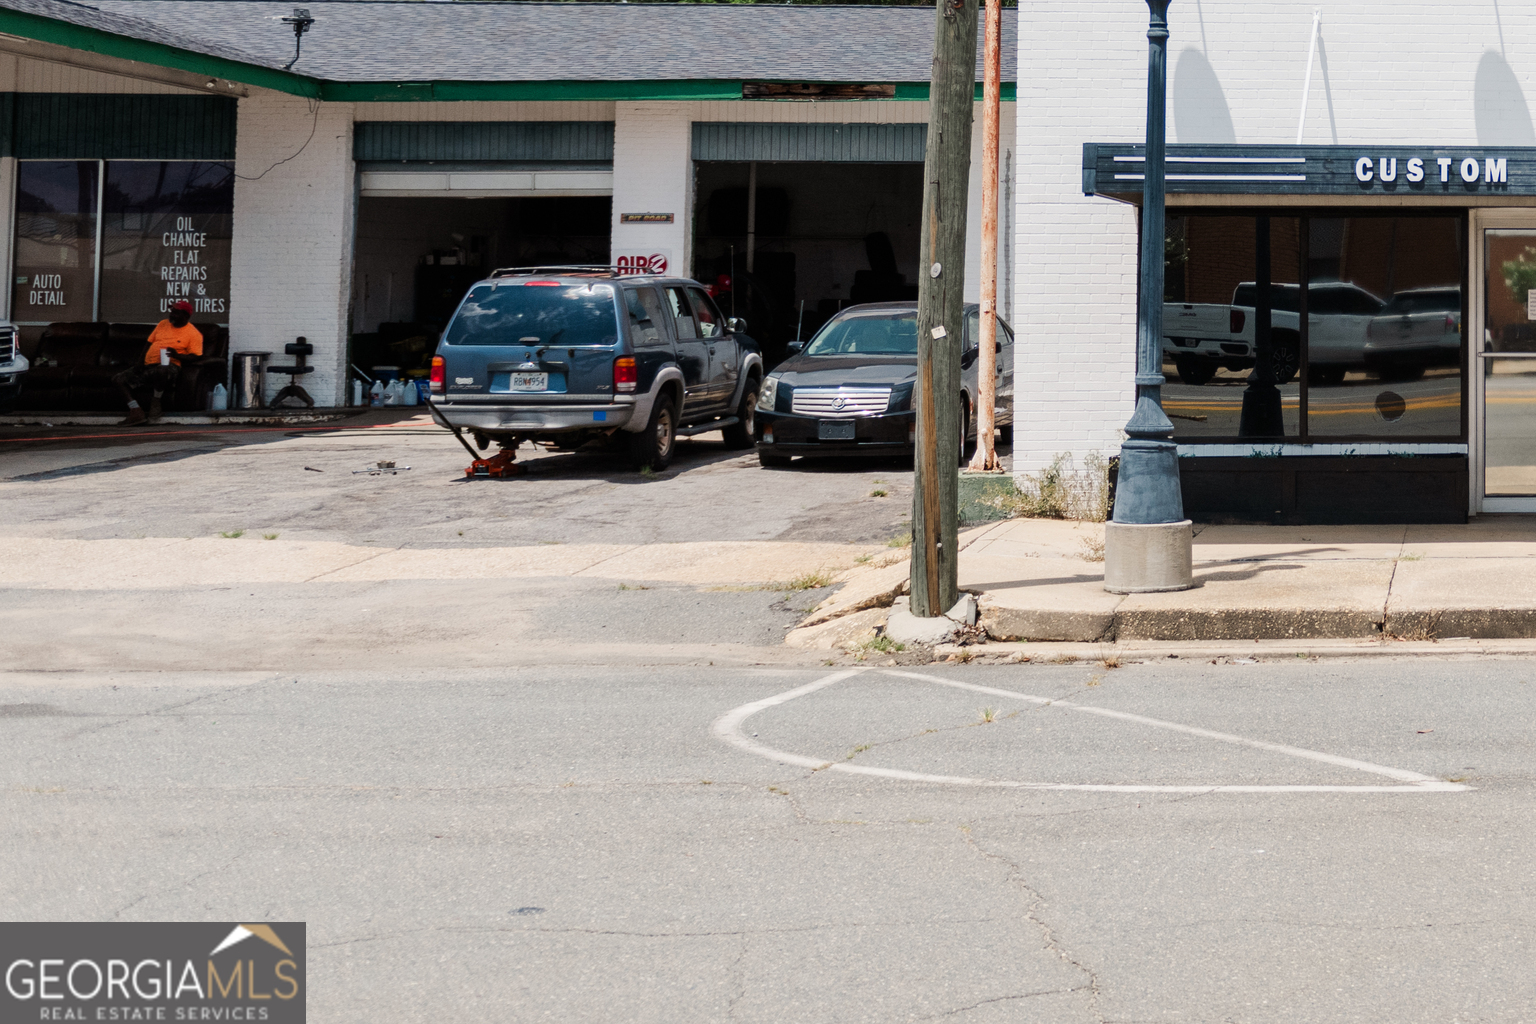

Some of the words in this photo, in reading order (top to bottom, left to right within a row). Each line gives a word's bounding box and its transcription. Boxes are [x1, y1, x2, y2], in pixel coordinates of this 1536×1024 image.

[1355, 156, 1508, 183] CUSTOM
[176, 216, 195, 231] OIL
[162, 232, 207, 247] CHANGE
[174, 250, 200, 265] FLAT
[161, 266, 208, 281] REPAIRS
[32, 274, 62, 289] AUTO
[166, 282, 191, 296] NEW
[197, 283, 206, 296] &
[29, 291, 67, 306] DETAIL
[160, 298, 190, 313] US
[194, 298, 225, 313] TIRES
